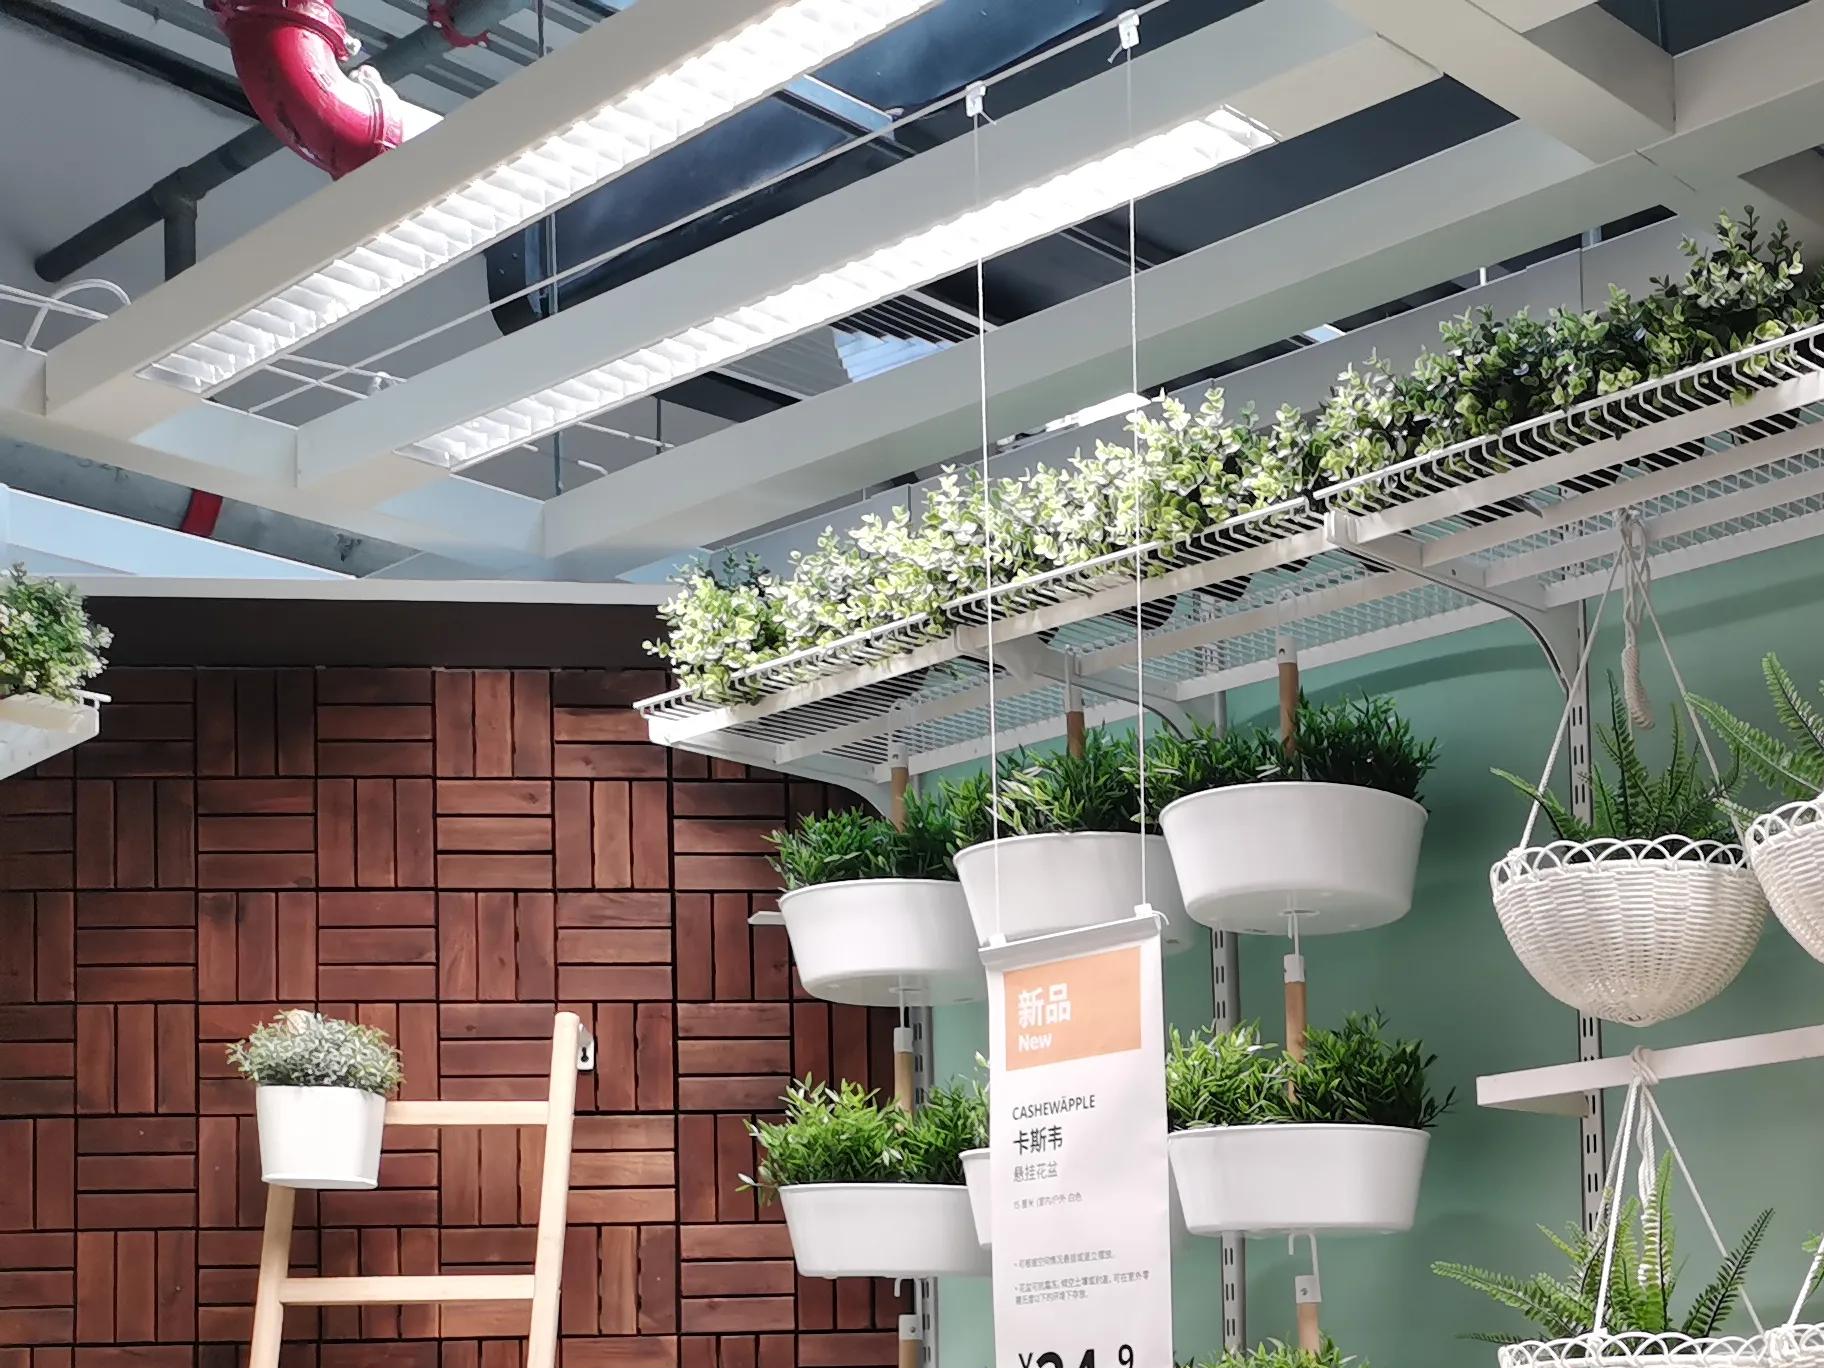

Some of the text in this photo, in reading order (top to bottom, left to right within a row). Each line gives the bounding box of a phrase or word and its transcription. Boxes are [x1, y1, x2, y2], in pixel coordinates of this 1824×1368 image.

[1018, 983, 1072, 1028] 新品
[1018, 1032, 1053, 1053] New
[1012, 1094, 1096, 1120] CASHEWÄPPLE
[1013, 1125, 1063, 1156] 卡斯韦
